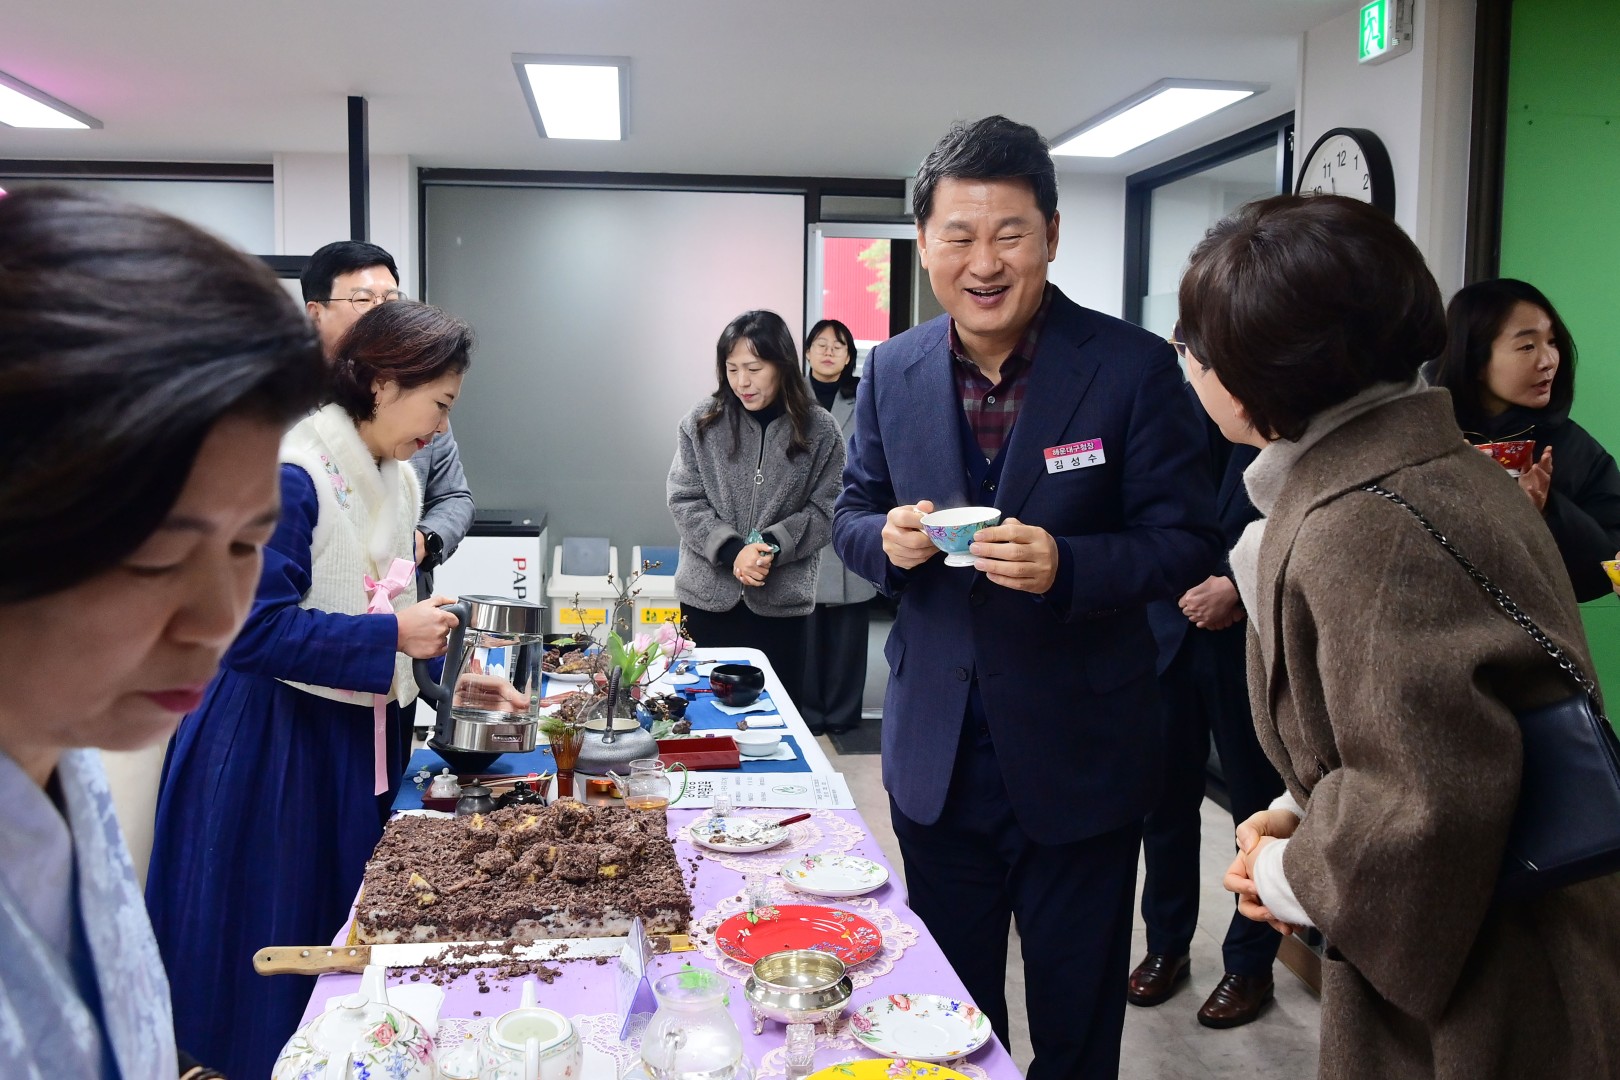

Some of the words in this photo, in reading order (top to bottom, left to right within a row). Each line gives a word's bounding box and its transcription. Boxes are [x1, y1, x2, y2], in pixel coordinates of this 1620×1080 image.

[1336, 149, 1347, 168] 12
[1354, 153, 1359, 171] 1
[1322, 161, 1332, 179] 11
[1362, 173, 1369, 190] 2
[1051, 442, 1094, 456] 해운대구청장
